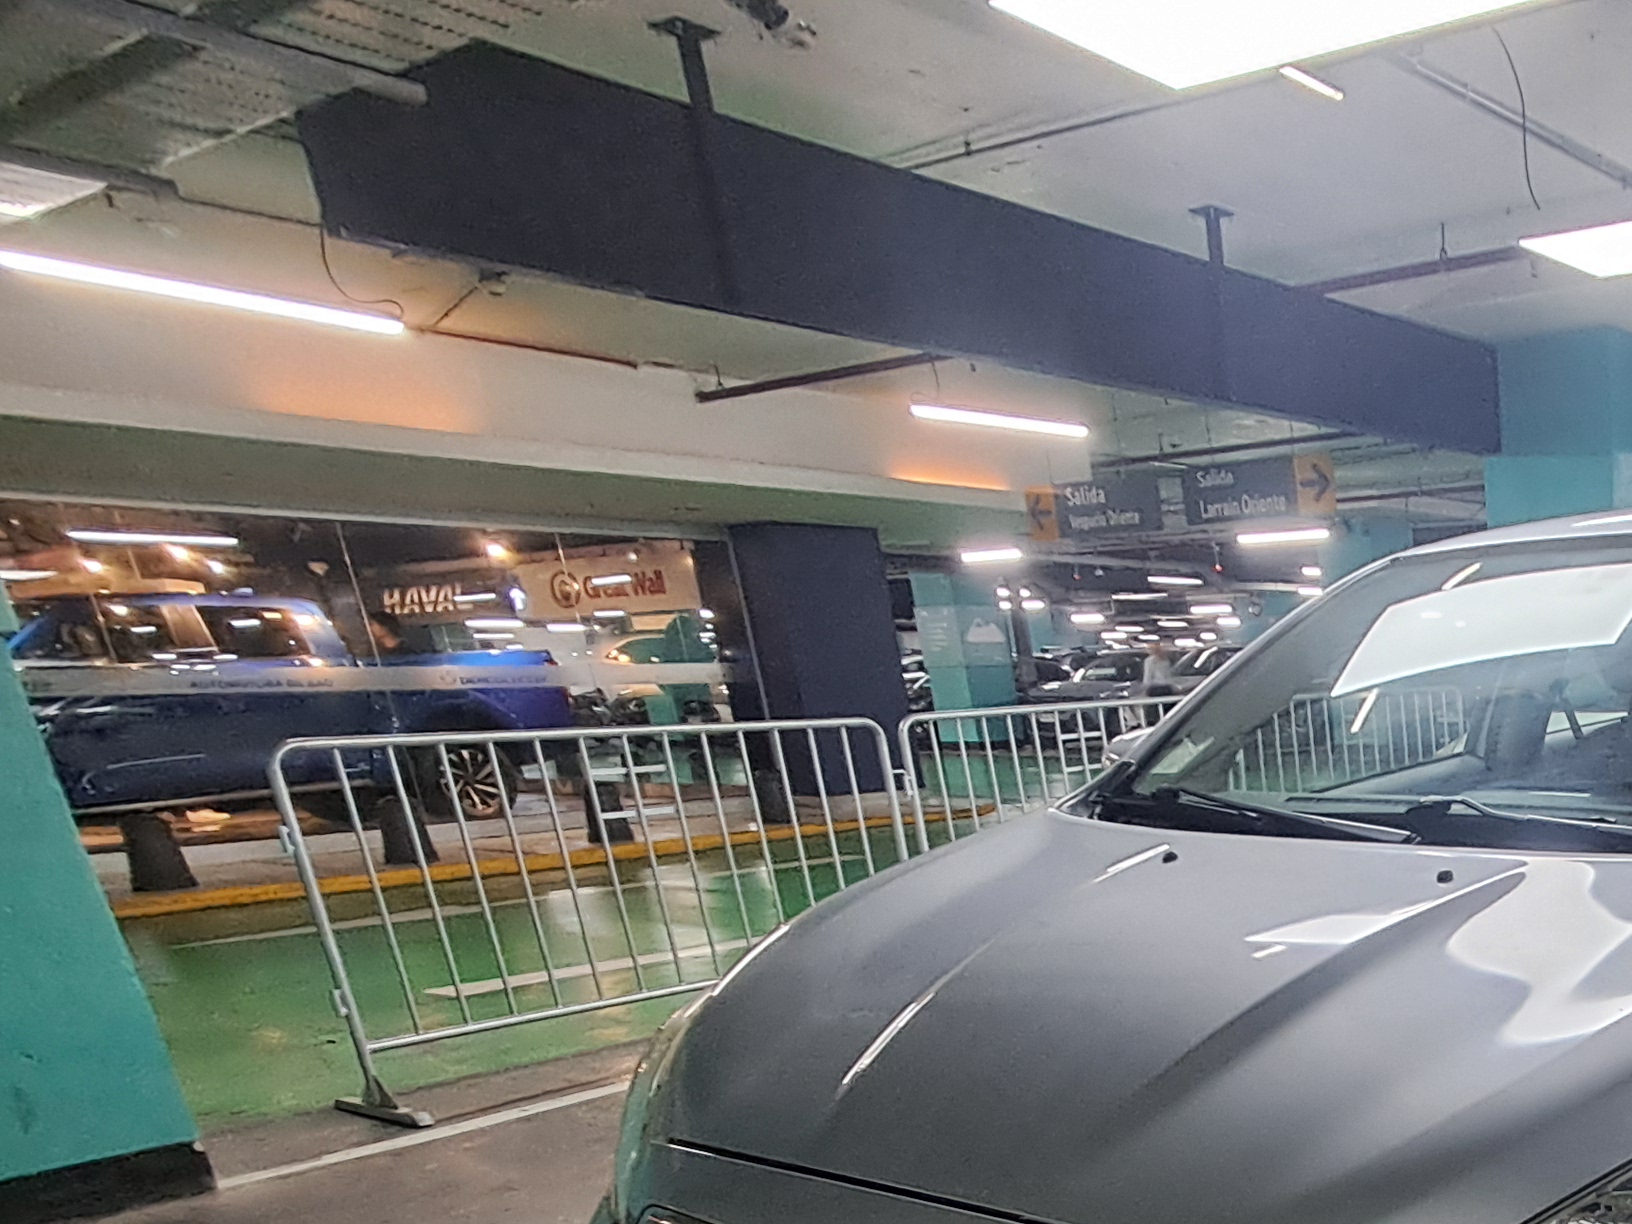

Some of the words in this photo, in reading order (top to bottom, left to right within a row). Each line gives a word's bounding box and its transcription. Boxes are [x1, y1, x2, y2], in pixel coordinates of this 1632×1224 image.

[1195, 467, 1235, 488] Salida
[1064, 485, 1106, 506] Salida
[1241, 493, 1286, 514] Oriente
[632, 569, 668, 597] Wall
[383, 583, 474, 615] HAVAL
